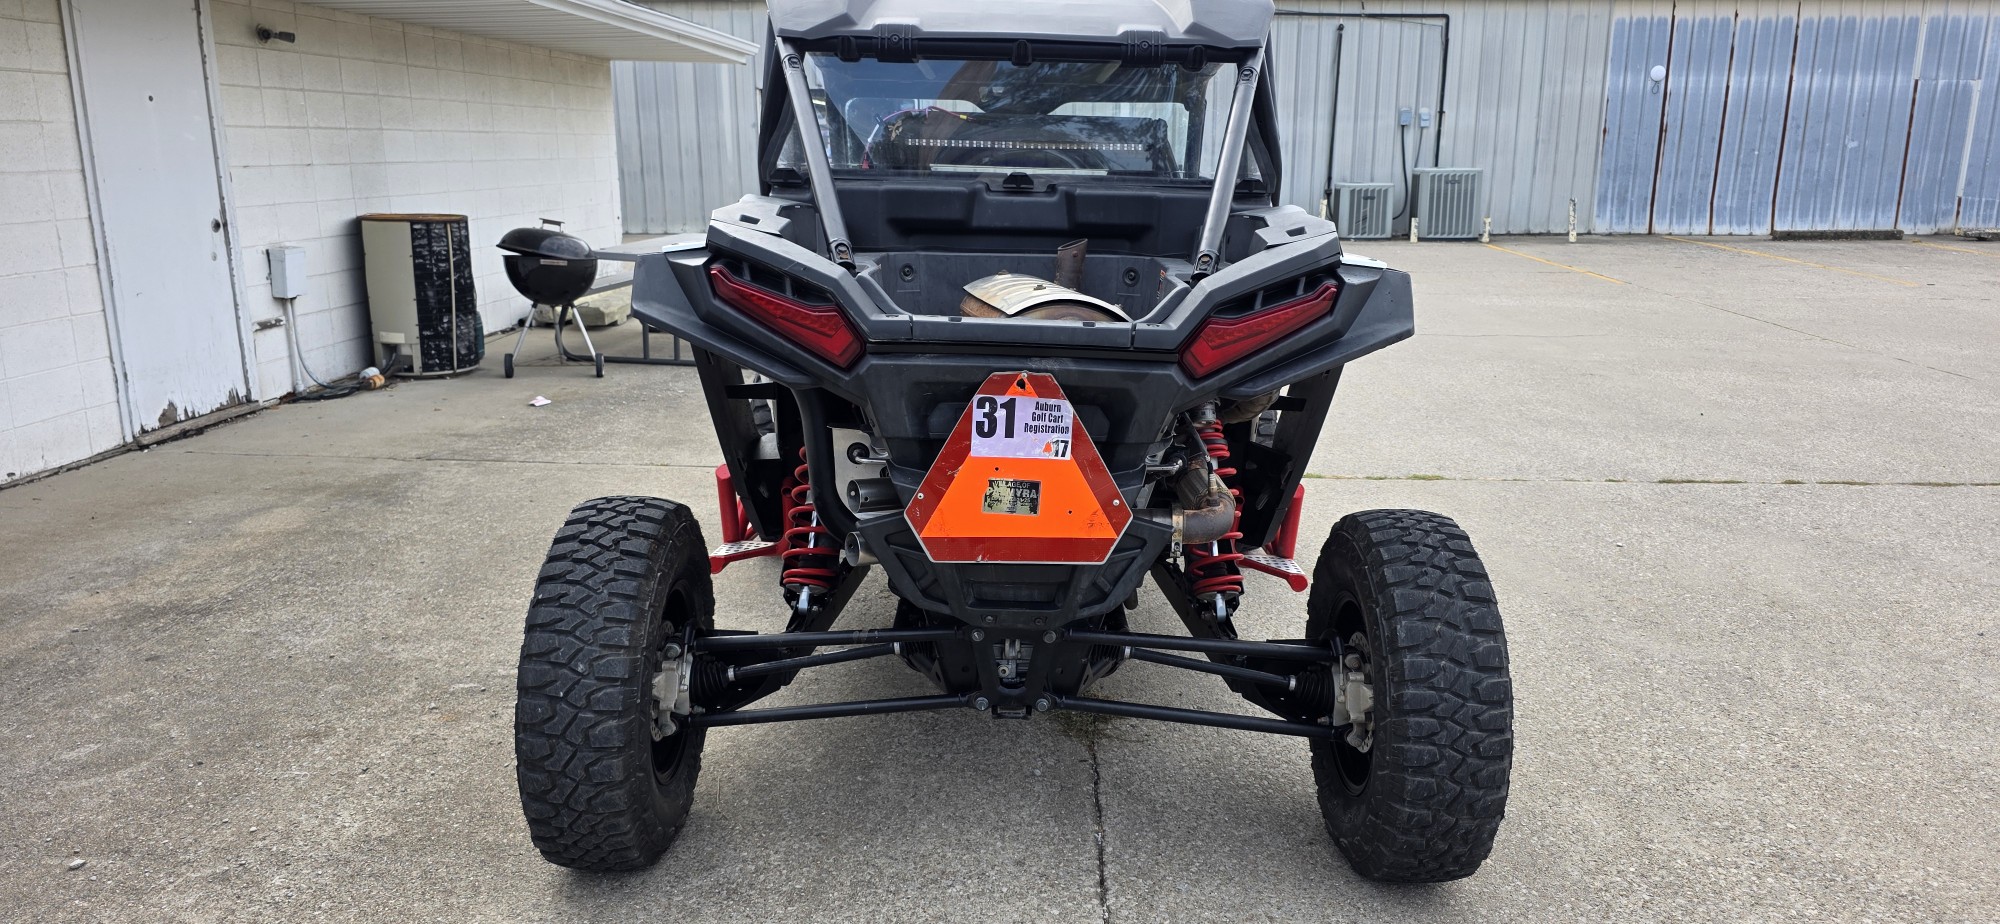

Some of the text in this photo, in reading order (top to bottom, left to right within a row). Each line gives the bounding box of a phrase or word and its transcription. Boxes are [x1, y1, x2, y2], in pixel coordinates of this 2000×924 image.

[1035, 401, 1062, 412] Auburn
[976, 396, 1016, 438] 31
[1031, 412, 1064, 423] Golf Cart
[1024, 423, 1070, 434] Registration
